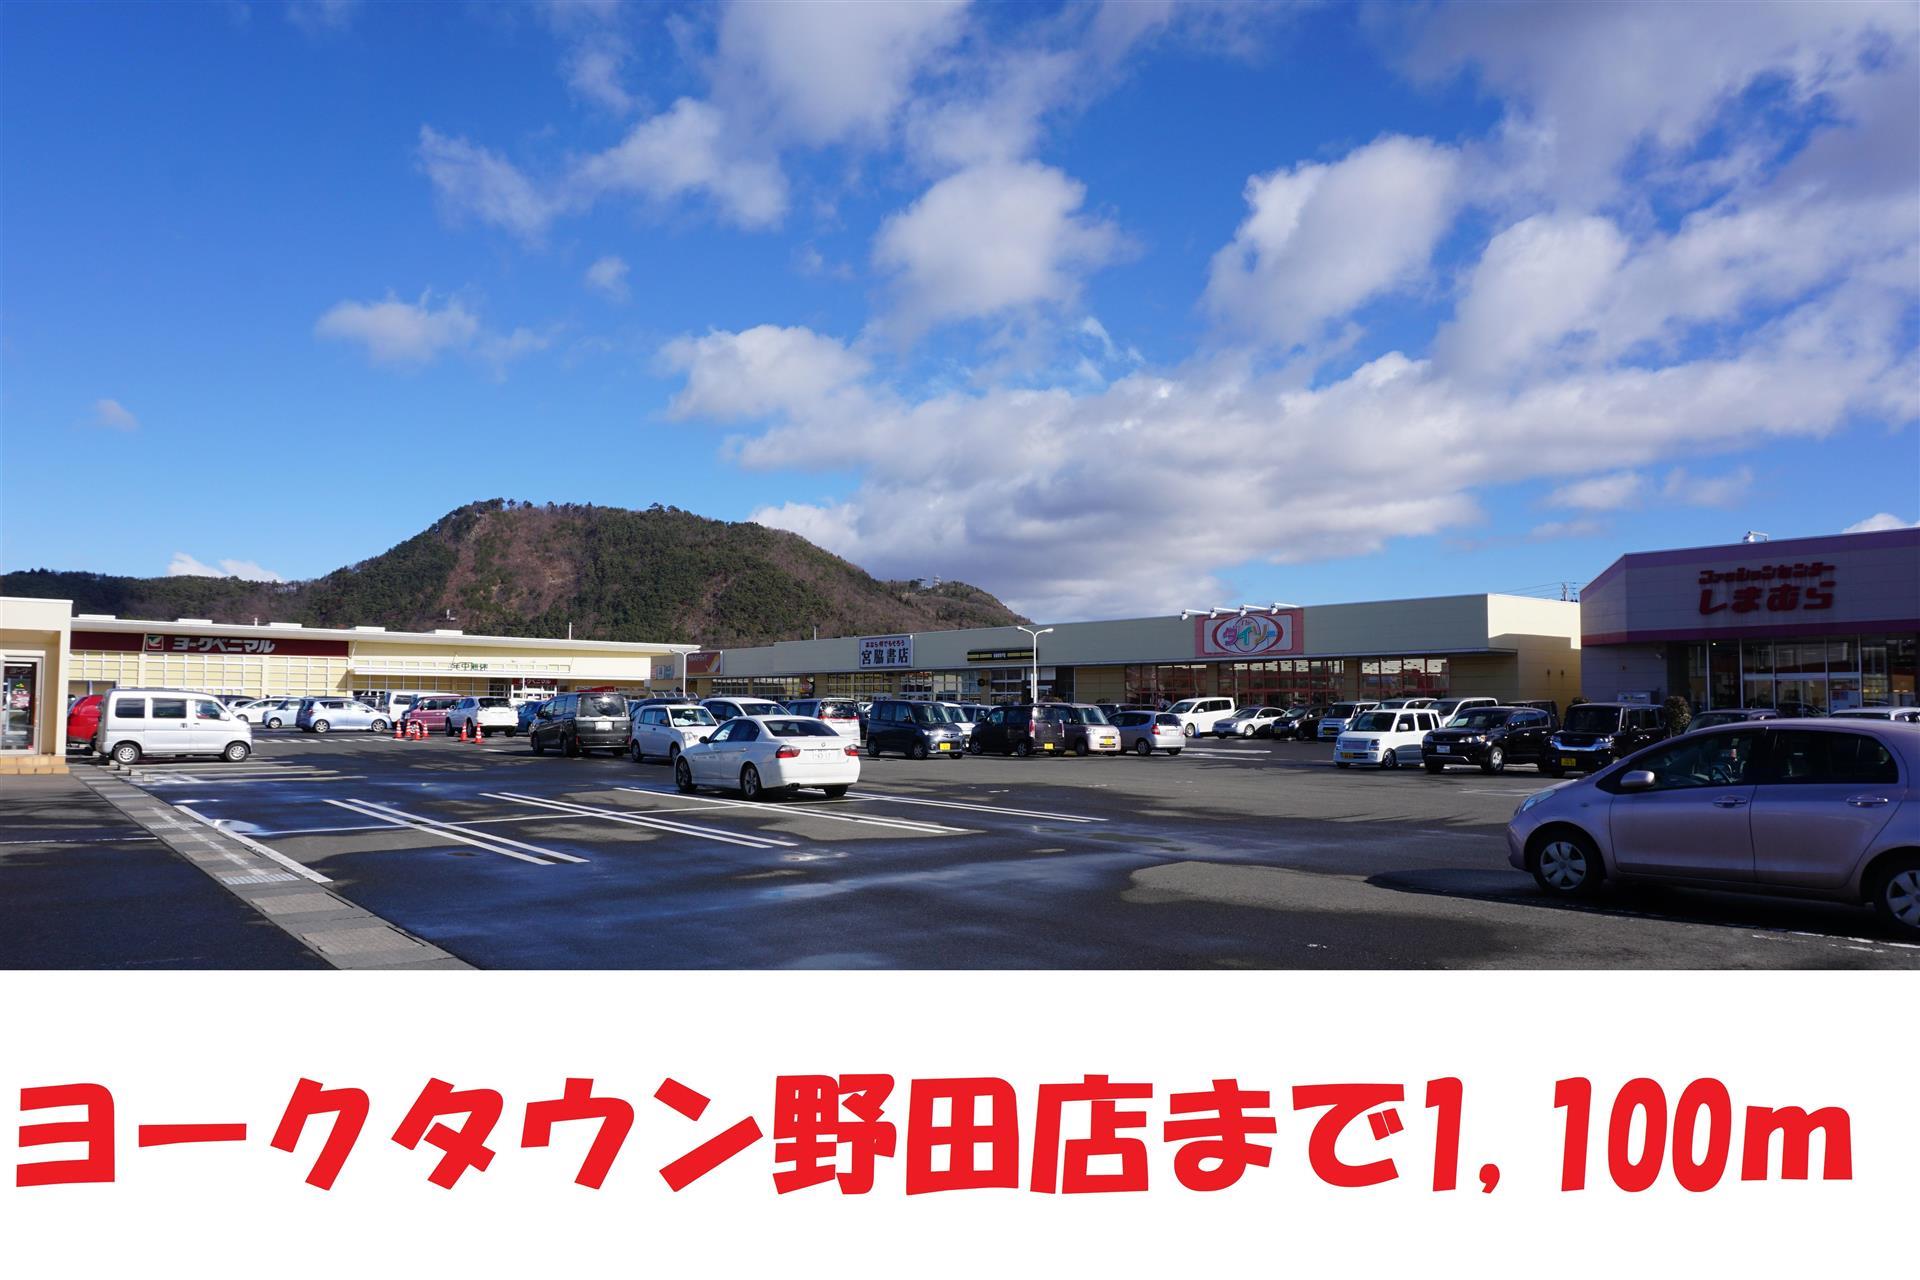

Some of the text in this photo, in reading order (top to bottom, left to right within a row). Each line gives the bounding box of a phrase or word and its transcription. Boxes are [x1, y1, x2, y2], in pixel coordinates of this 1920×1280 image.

[1698, 581, 1837, 615] しまむら
[172, 636, 276, 653] ヨークベニマル
[1222, 623, 1277, 646] ダイソー
[862, 647, 909, 664] 宮脇書店
